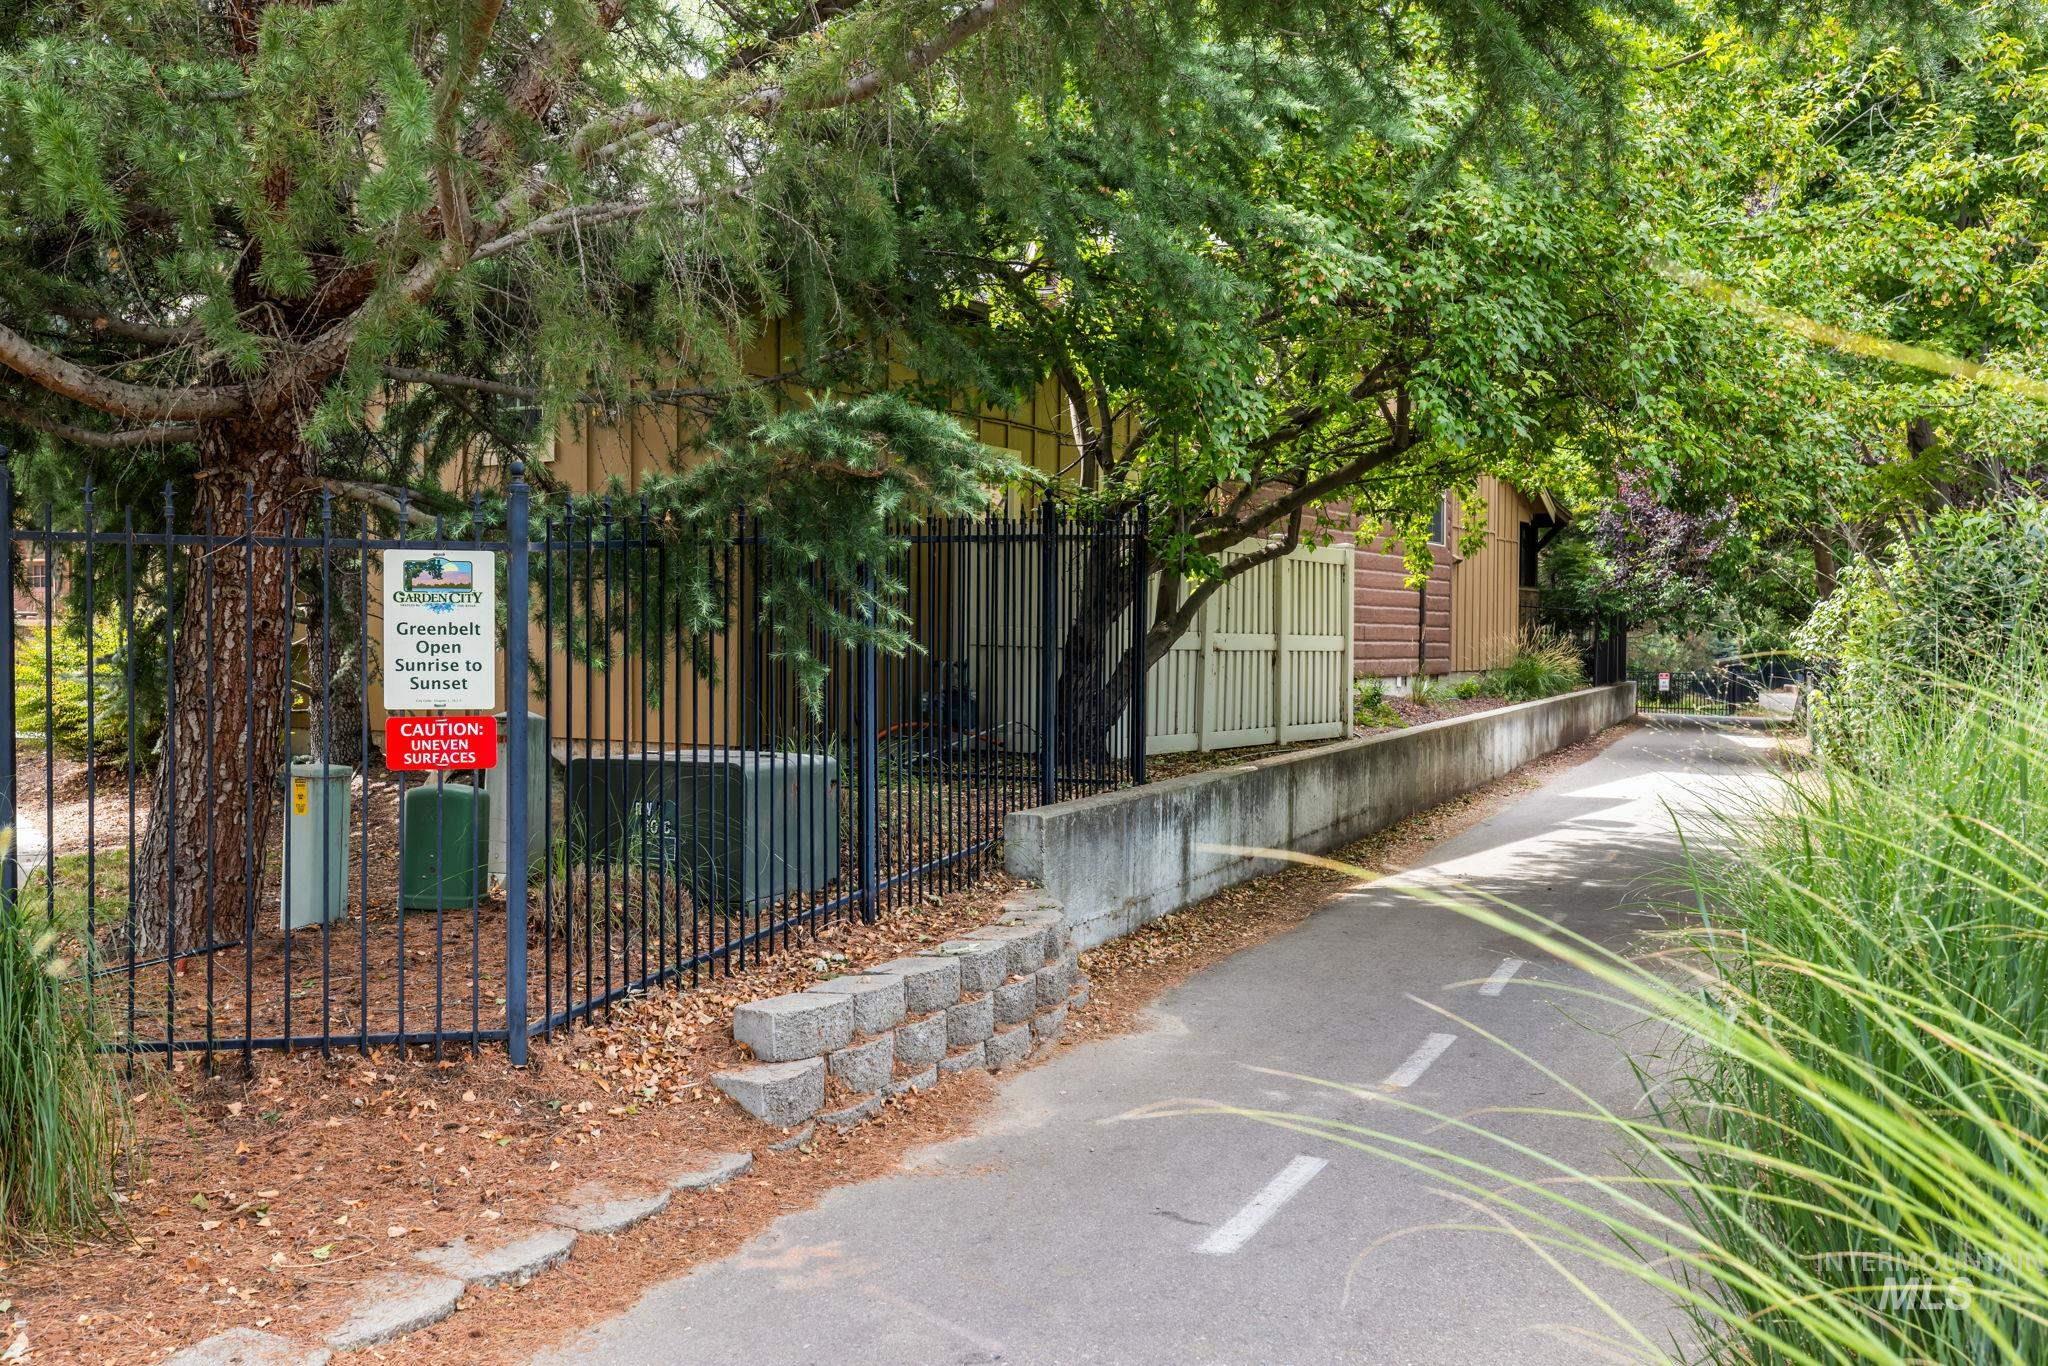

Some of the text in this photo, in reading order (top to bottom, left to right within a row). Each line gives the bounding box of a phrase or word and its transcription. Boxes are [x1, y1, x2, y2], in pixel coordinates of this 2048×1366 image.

[392, 590, 483, 604] GARDEN CITY
[396, 622, 481, 636] Greenbelt
[416, 640, 462, 656] Open
[395, 658, 482, 672] Sunrise to
[410, 676, 468, 690] Sunset
[400, 723, 484, 737] CAUTION:
[411, 739, 469, 751] UNEVEN
[403, 752, 476, 764] SURFACES
